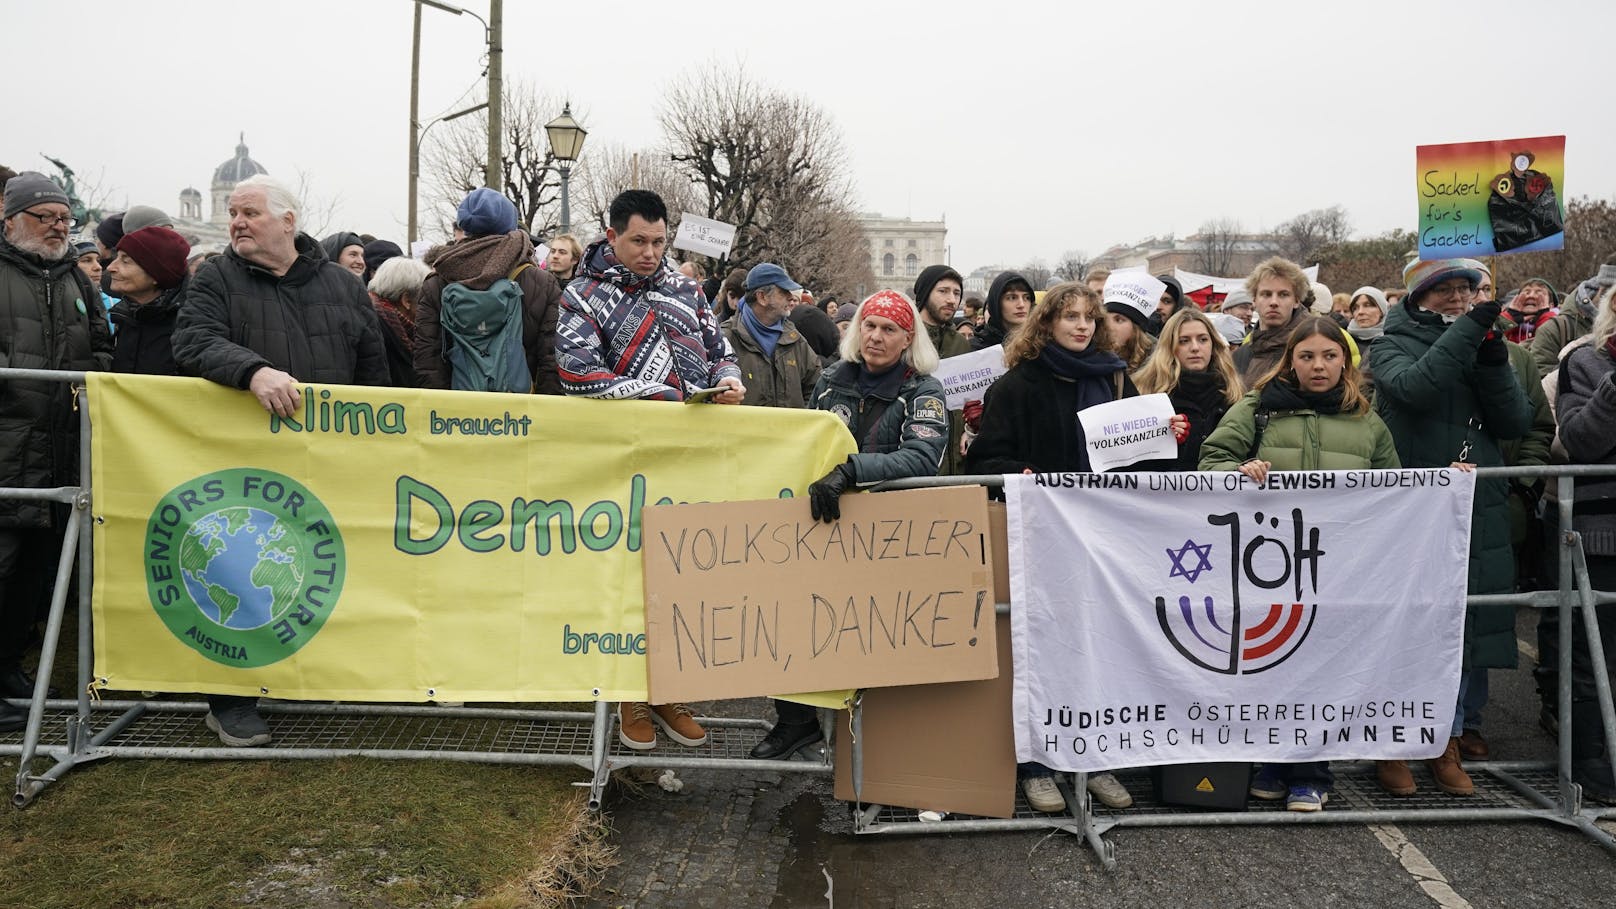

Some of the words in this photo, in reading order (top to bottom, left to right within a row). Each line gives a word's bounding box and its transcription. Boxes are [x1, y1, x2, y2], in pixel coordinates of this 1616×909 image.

[1422, 170, 1480, 198] Sackerl
[1426, 203, 1462, 221] für's
[1422, 224, 1482, 248] Gackerl
[611, 314, 641, 354] EANS
[943, 376, 958, 386] NIE
[960, 368, 992, 381] WIEDER
[944, 375, 1001, 395] OLKSKANZLE
[430, 411, 532, 437] braucht
[1103, 424, 1120, 435] NIE
[1122, 416, 1158, 432] WIEDER
[1034, 472, 1138, 489] AUSTRIAN
[1150, 474, 1213, 491] UNION
[1224, 474, 1248, 490] OF
[1345, 470, 1451, 488] STUDENTS
[243, 476, 305, 517] FOR
[151, 479, 224, 606] SENIORS
[272, 519, 337, 645] FUTURE
[185, 625, 248, 661] AUSTRIA
[563, 624, 647, 655] brauc
[672, 596, 792, 671] NEIN,
[1044, 704, 1166, 728] JÜDISCHE
[1188, 701, 1435, 722] ÖSTERREICHISCHE
[1045, 725, 1435, 755] HOCHSCHÜLERINNEN
